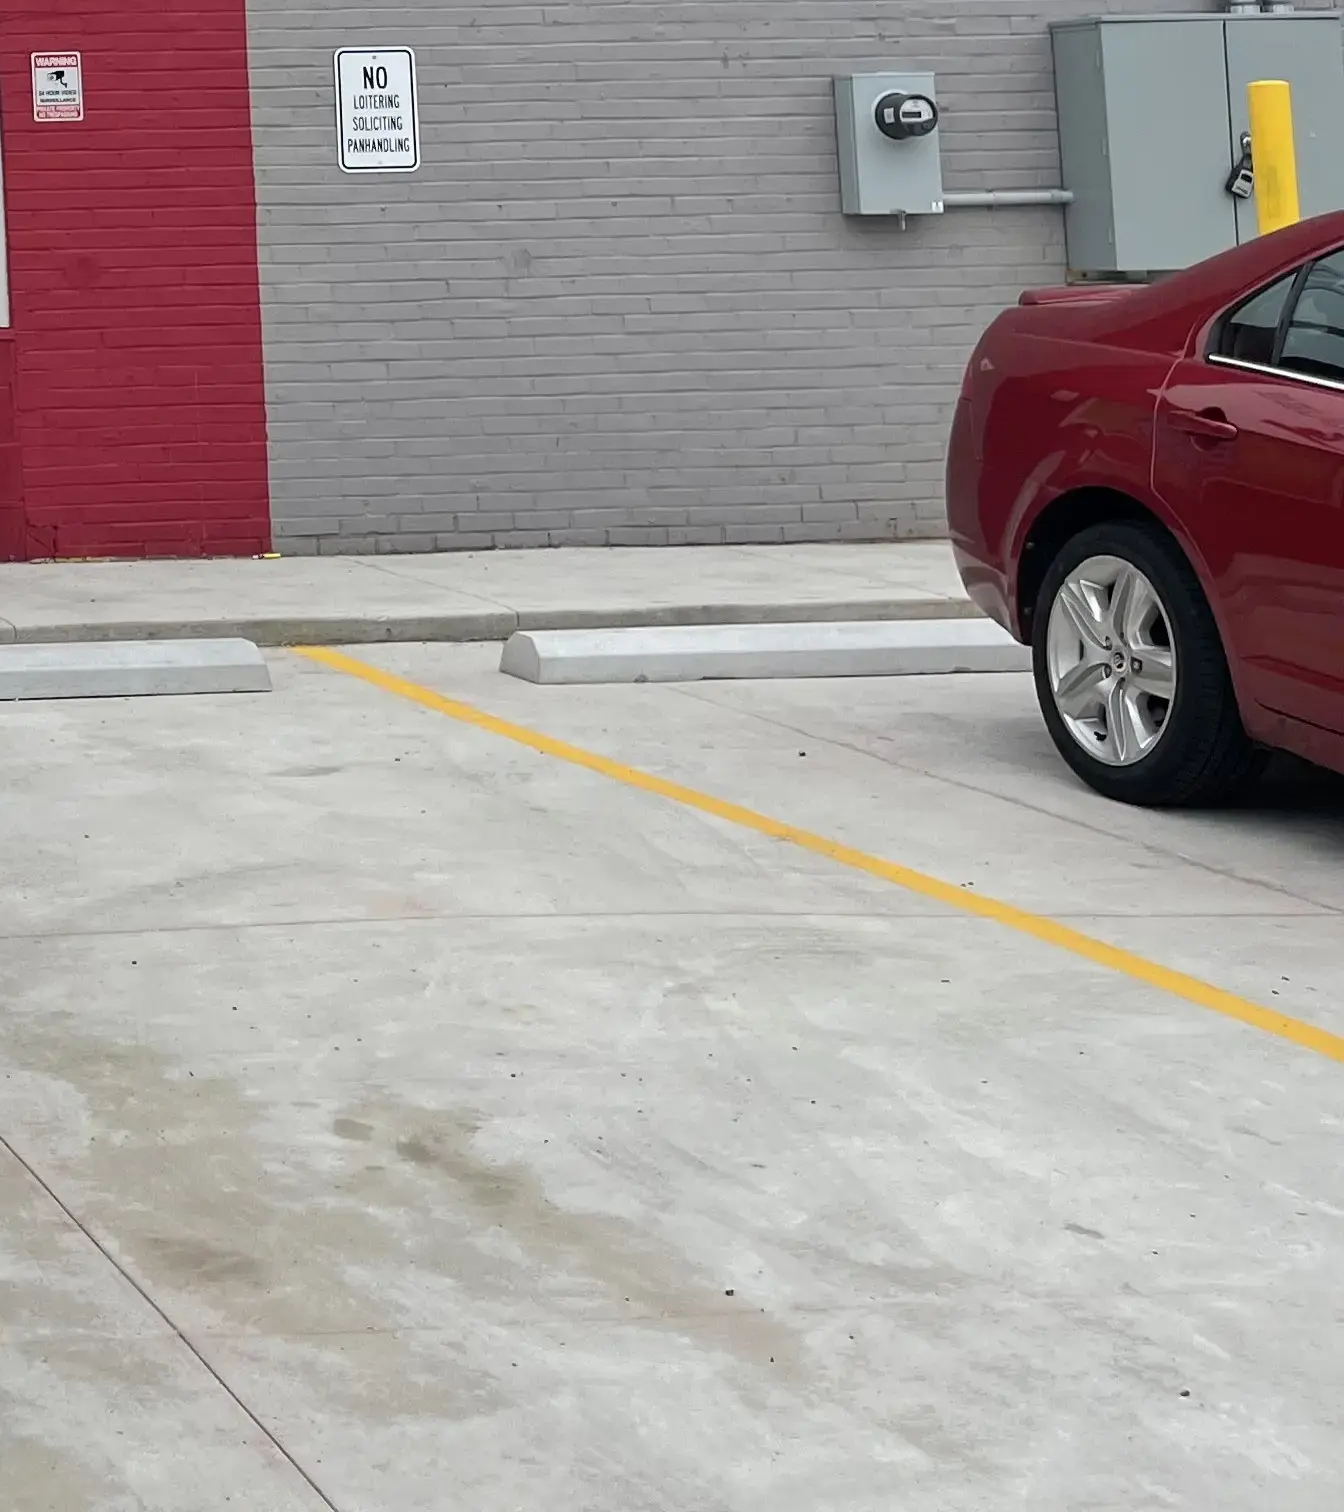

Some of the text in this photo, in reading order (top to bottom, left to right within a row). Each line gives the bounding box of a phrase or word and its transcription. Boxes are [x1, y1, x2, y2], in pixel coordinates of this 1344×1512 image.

[35, 56, 77, 66] WARNING
[362, 65, 388, 90] NO
[353, 94, 400, 110] LOITERING
[352, 116, 403, 131] SOLICITING
[347, 137, 410, 153] PANHANDLING
